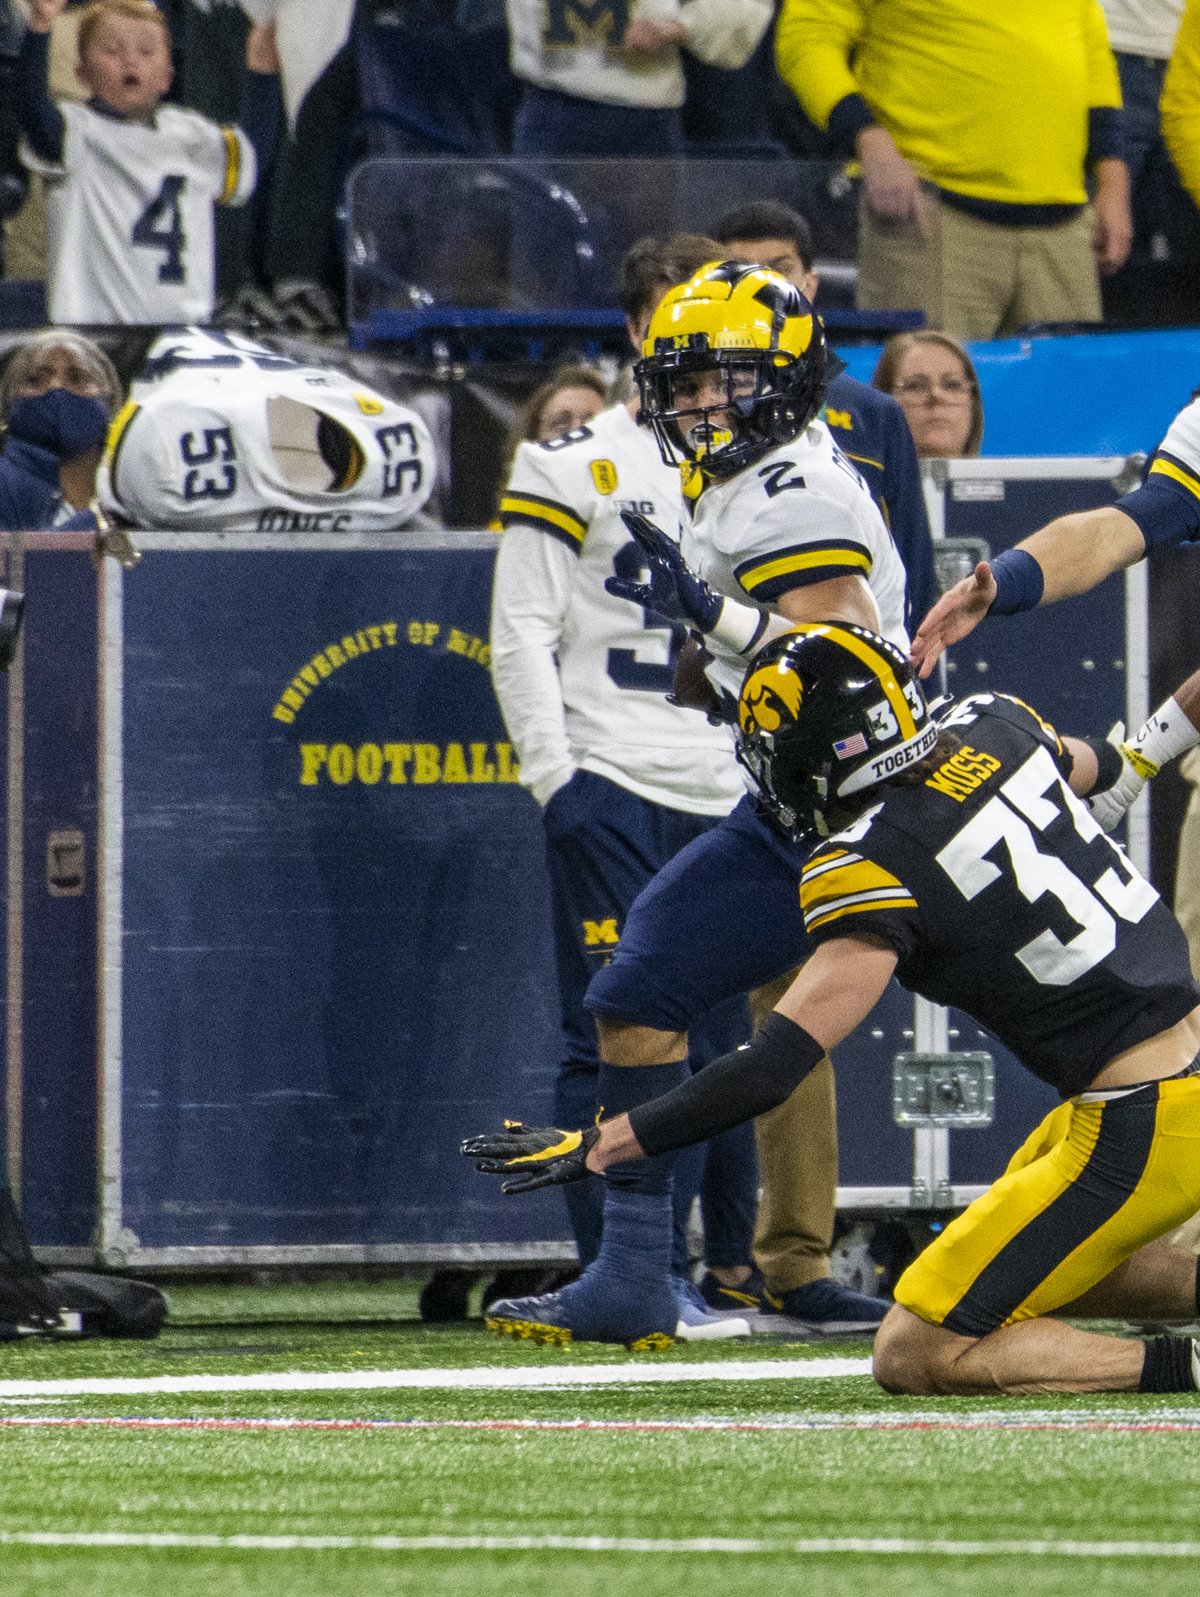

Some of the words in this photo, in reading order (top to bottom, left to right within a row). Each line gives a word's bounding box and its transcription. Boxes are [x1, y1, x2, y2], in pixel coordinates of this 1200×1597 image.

[132, 174, 186, 285] 4
[673, 335, 690, 349] M
[827, 408, 853, 430] M
[179, 426, 237, 501] 53
[759, 461, 806, 498] 2
[407, 620, 440, 646] OF
[299, 742, 521, 786] FOOTBALL
[871, 726, 937, 778] TOGETHE
[925, 745, 1002, 803] MOSS
[935, 744, 1160, 986] 33
[582, 918, 619, 945] M
